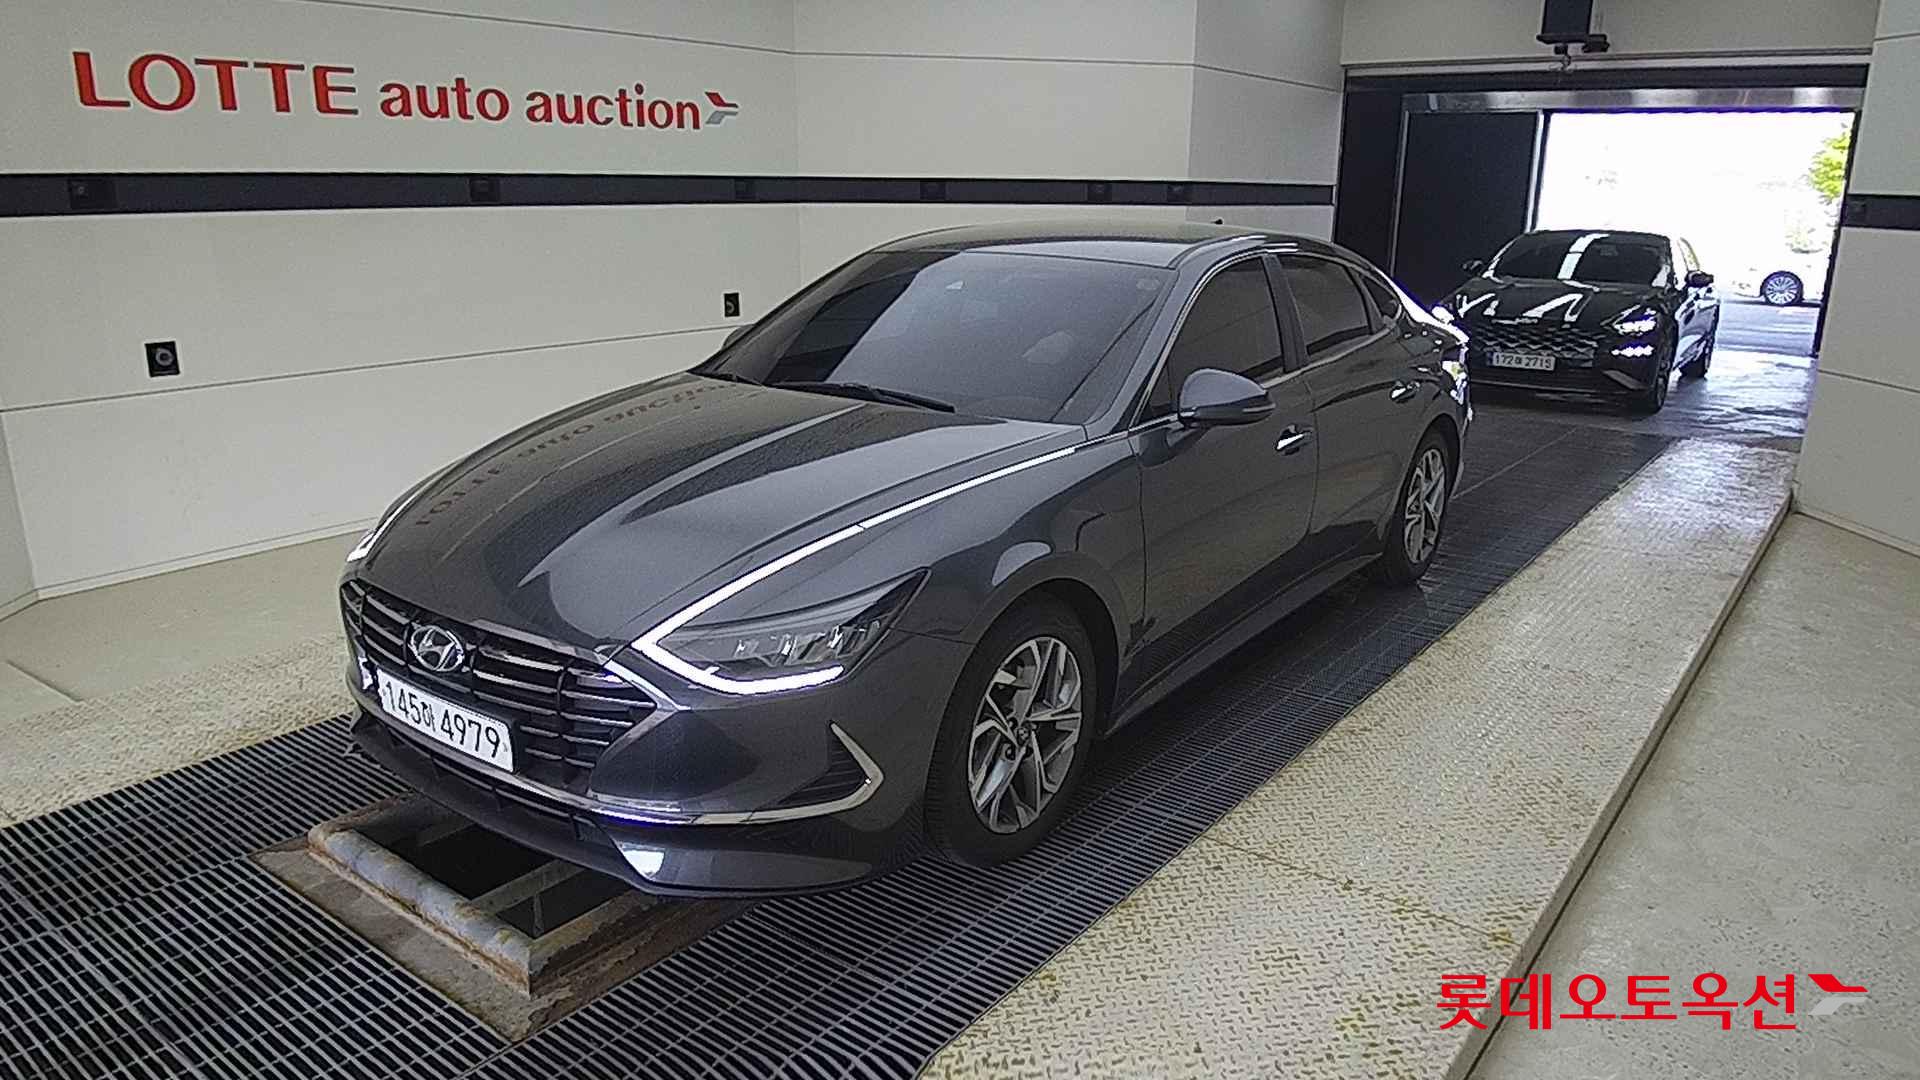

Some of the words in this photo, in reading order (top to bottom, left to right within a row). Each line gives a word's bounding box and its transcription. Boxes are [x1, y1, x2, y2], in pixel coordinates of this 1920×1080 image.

[72, 51, 359, 116] LOTTE
[379, 77, 510, 122] auto
[525, 83, 701, 130] auction
[440, 708, 501, 759] 4979
